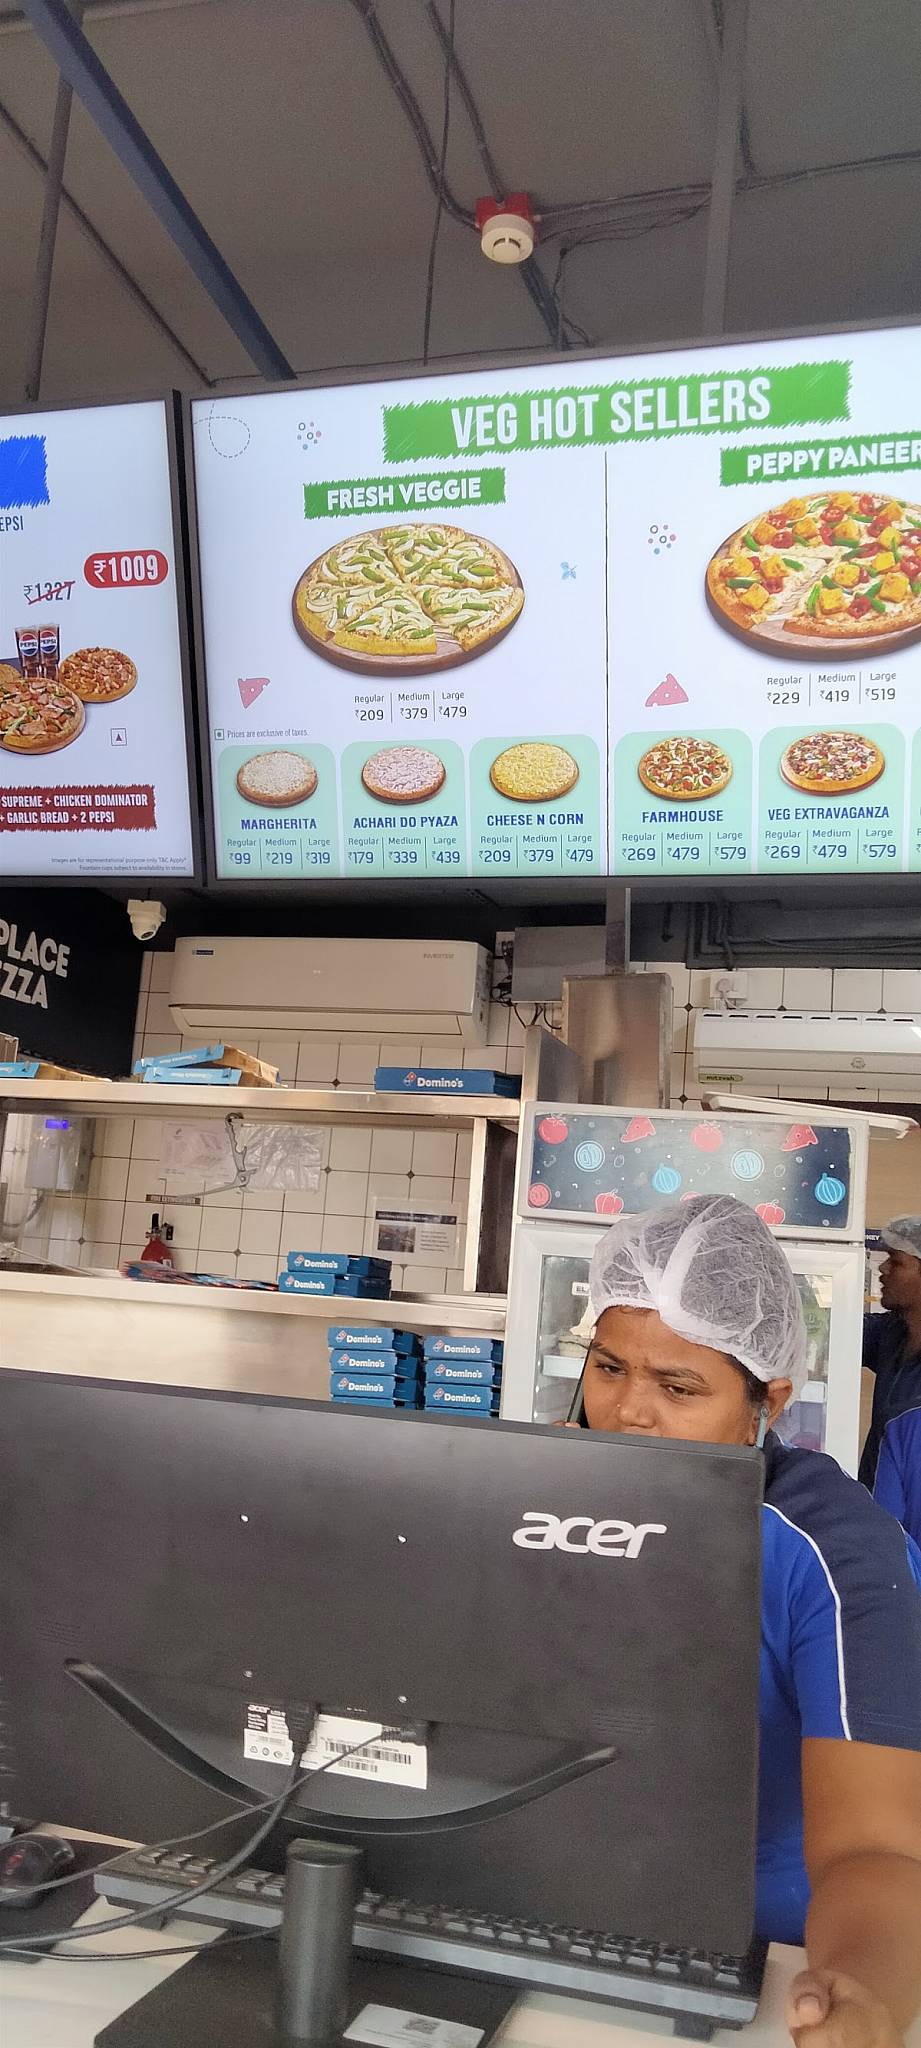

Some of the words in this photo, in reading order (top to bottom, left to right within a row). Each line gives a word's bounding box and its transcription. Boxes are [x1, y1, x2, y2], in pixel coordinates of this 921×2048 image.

[451, 403, 517, 448] VEG
[530, 394, 600, 441] HOT
[610, 377, 771, 433] SELLERS
[747, 448, 825, 477] PEPPY
[829, 440, 921, 469] PANEER
[327, 485, 394, 511] FRESH
[399, 477, 481, 505] VEGGIE
[93, 555, 158, 583] ₹1009
[23, 581, 74, 603] ₹1327
[766, 677, 802, 686] Regular
[818, 674, 855, 683] Medium
[870, 672, 896, 682] Large
[354, 694, 385, 704] Regular
[398, 693, 430, 701] Medium
[442, 691, 465, 701] Large
[767, 691, 800, 705] ₹229
[819, 689, 850, 703] ₹419
[865, 688, 896, 701] ₹519
[354, 709, 384, 721] ₹209
[400, 708, 428, 719] ₹379
[438, 706, 467, 718] ₹479
[227, 730, 245, 738] Prices
[256, 729, 284, 738] exclusive
[285, 729, 291, 737] of
[1, 795, 43, 808] SUPREME
[54, 795, 92, 807] CHICKEN
[95, 794, 148, 806] DOMINATOR
[7, 812, 38, 824] GARLIC
[41, 812, 69, 823] BREAD
[81, 812, 87, 823] 2
[89, 811, 115, 823] PEPSI
[487, 815, 533, 826] CHEESE
[536, 814, 545, 826] N
[549, 813, 584, 825] CORN
[642, 810, 724, 823] FARMHOUSE
[768, 808, 790, 821] VEG
[794, 806, 890, 820] EXTRAVAGANZA
[241, 818, 317, 830] MARGHERITA
[353, 817, 396, 829] ACHARI
[400, 817, 416, 828] DO
[420, 815, 458, 827] PYAZA
[480, 836, 513, 845] Regular
[523, 835, 558, 843] Medium
[567, 834, 592, 844] Large
[622, 833, 656, 842] Regular
[666, 832, 704, 841] Medium
[717, 831, 743, 841] Large
[765, 830, 801, 840] Regular
[812, 829, 851, 838] Medium
[866, 828, 893, 838] Large
[227, 838, 256, 847] Regular
[265, 838, 297, 846] Medium
[308, 838, 331, 847] Large
[348, 837, 379, 846] Regular
[388, 837, 422, 845] Medium
[433, 836, 457, 845] Large
[229, 852, 251, 865] ₹99
[266, 852, 293, 865] ₹219
[306, 852, 330, 864] ₹319
[347, 851, 374, 864] ₹179
[388, 851, 418, 864] ₹339
[432, 850, 460, 864] ₹439
[479, 850, 511, 863] ₹209
[524, 849, 554, 862] ₹379
[566, 849, 594, 862] ₹479
[622, 847, 656, 861] ₹269
[667, 847, 700, 860] ₹479
[714, 846, 747, 860] ₹579
[765, 845, 800, 859] ₹269
[812, 845, 847, 858] ₹479
[863, 845, 896, 858] ₹579
[0, 919, 71, 978] PLACE
[0, 961, 48, 1009] ZZA
[417, 1077, 464, 1089] Domino's
[304, 1258, 338, 1269] Domino's
[293, 1280, 325, 1290] Domino's
[346, 1334, 383, 1344] Domino's
[444, 1344, 481, 1354] Domino's
[349, 1358, 385, 1369] Domino's
[445, 1368, 483, 1379] Domino's
[348, 1382, 384, 1392] Domino's
[444, 1393, 481, 1403] Domino's
[512, 1512, 667, 1559] acer
